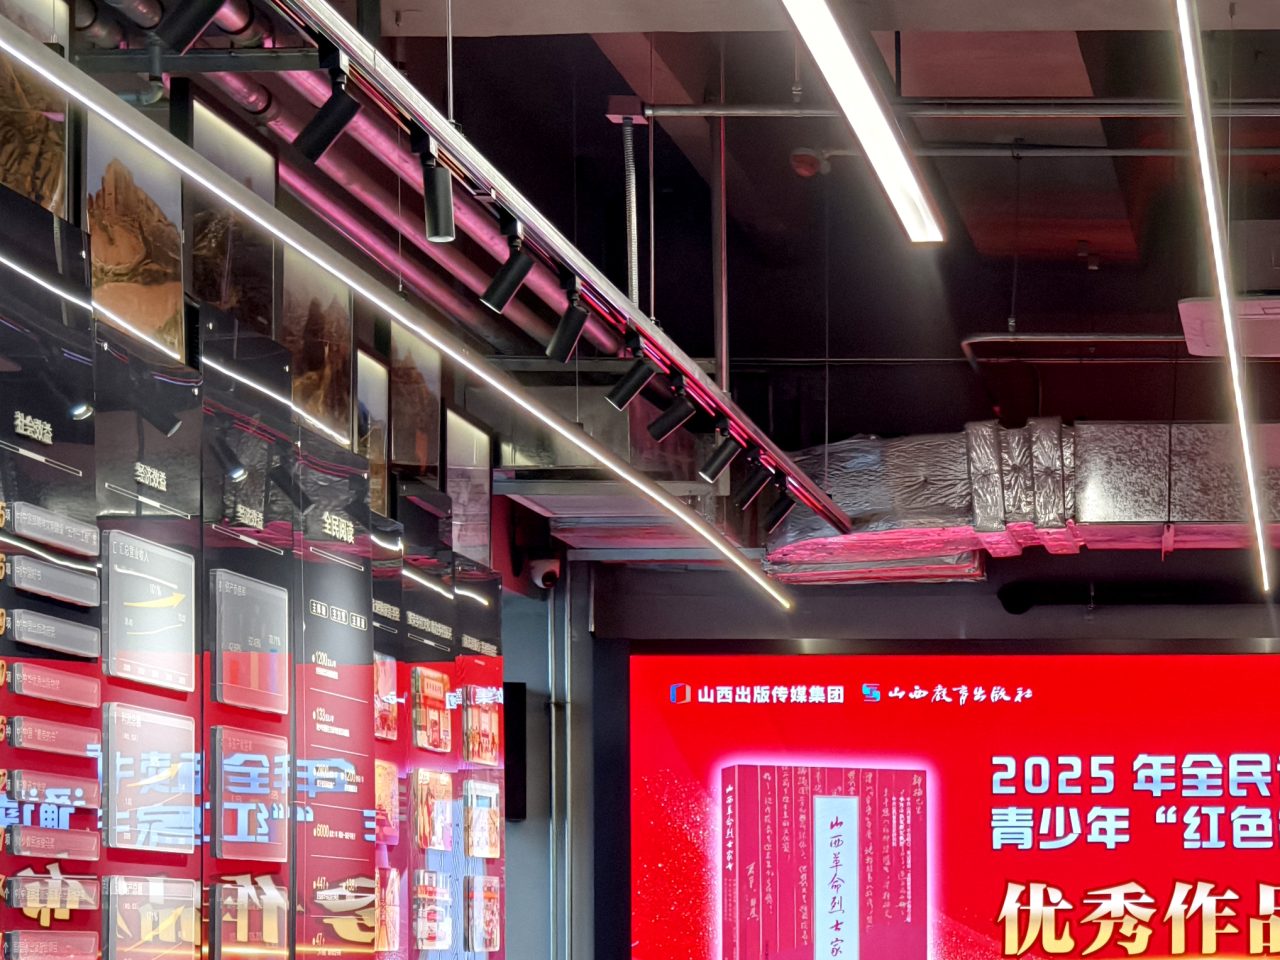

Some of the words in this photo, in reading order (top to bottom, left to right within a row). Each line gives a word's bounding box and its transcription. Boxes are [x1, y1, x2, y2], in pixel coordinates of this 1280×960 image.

[698, 685, 844, 703] 山西出版传媒集团
[888, 684, 1033, 705] 山西教育出版社
